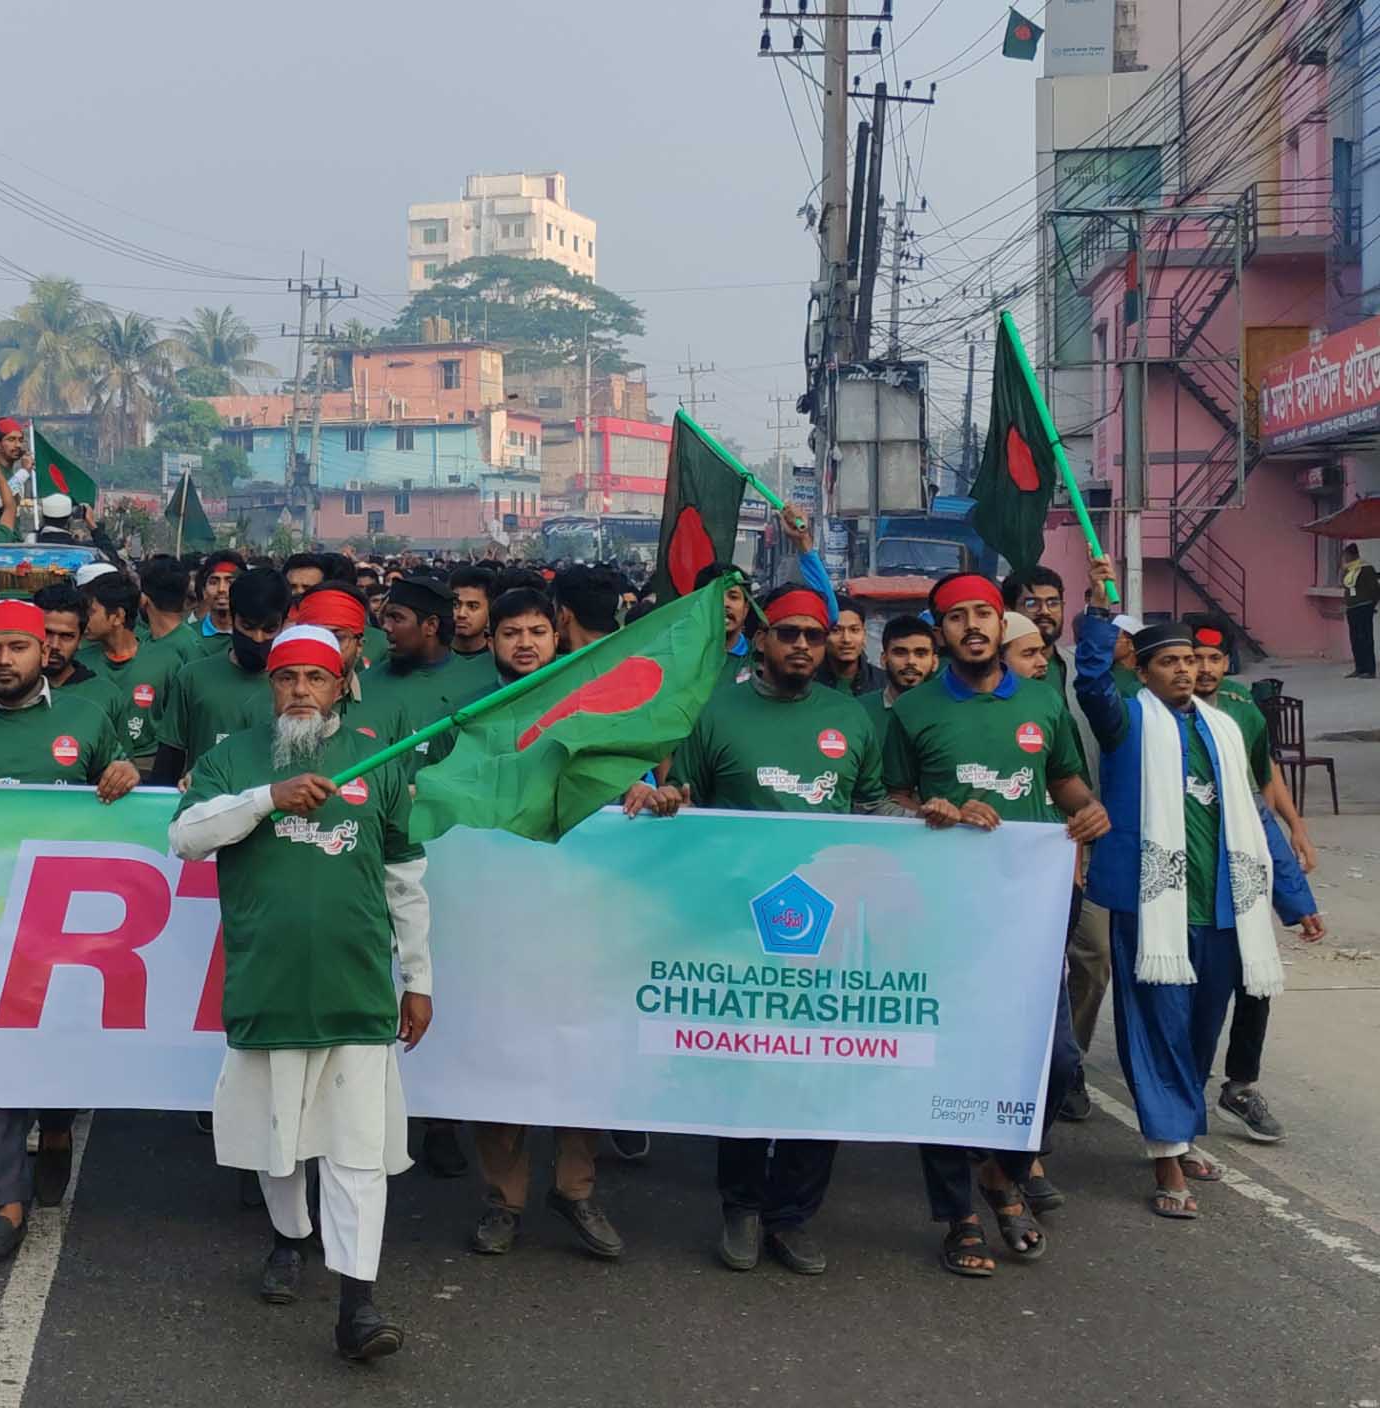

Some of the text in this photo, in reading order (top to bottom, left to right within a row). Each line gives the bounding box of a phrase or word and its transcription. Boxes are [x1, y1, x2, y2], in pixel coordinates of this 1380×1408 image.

[650, 961, 929, 992] BANGLADESH ISLAMI
[635, 985, 940, 1025] CHHATRASHIBIR
[674, 1029, 899, 1059] NOAKHALI TOWN
[931, 1095, 990, 1113] Branding
[931, 1107, 976, 1124] Design
